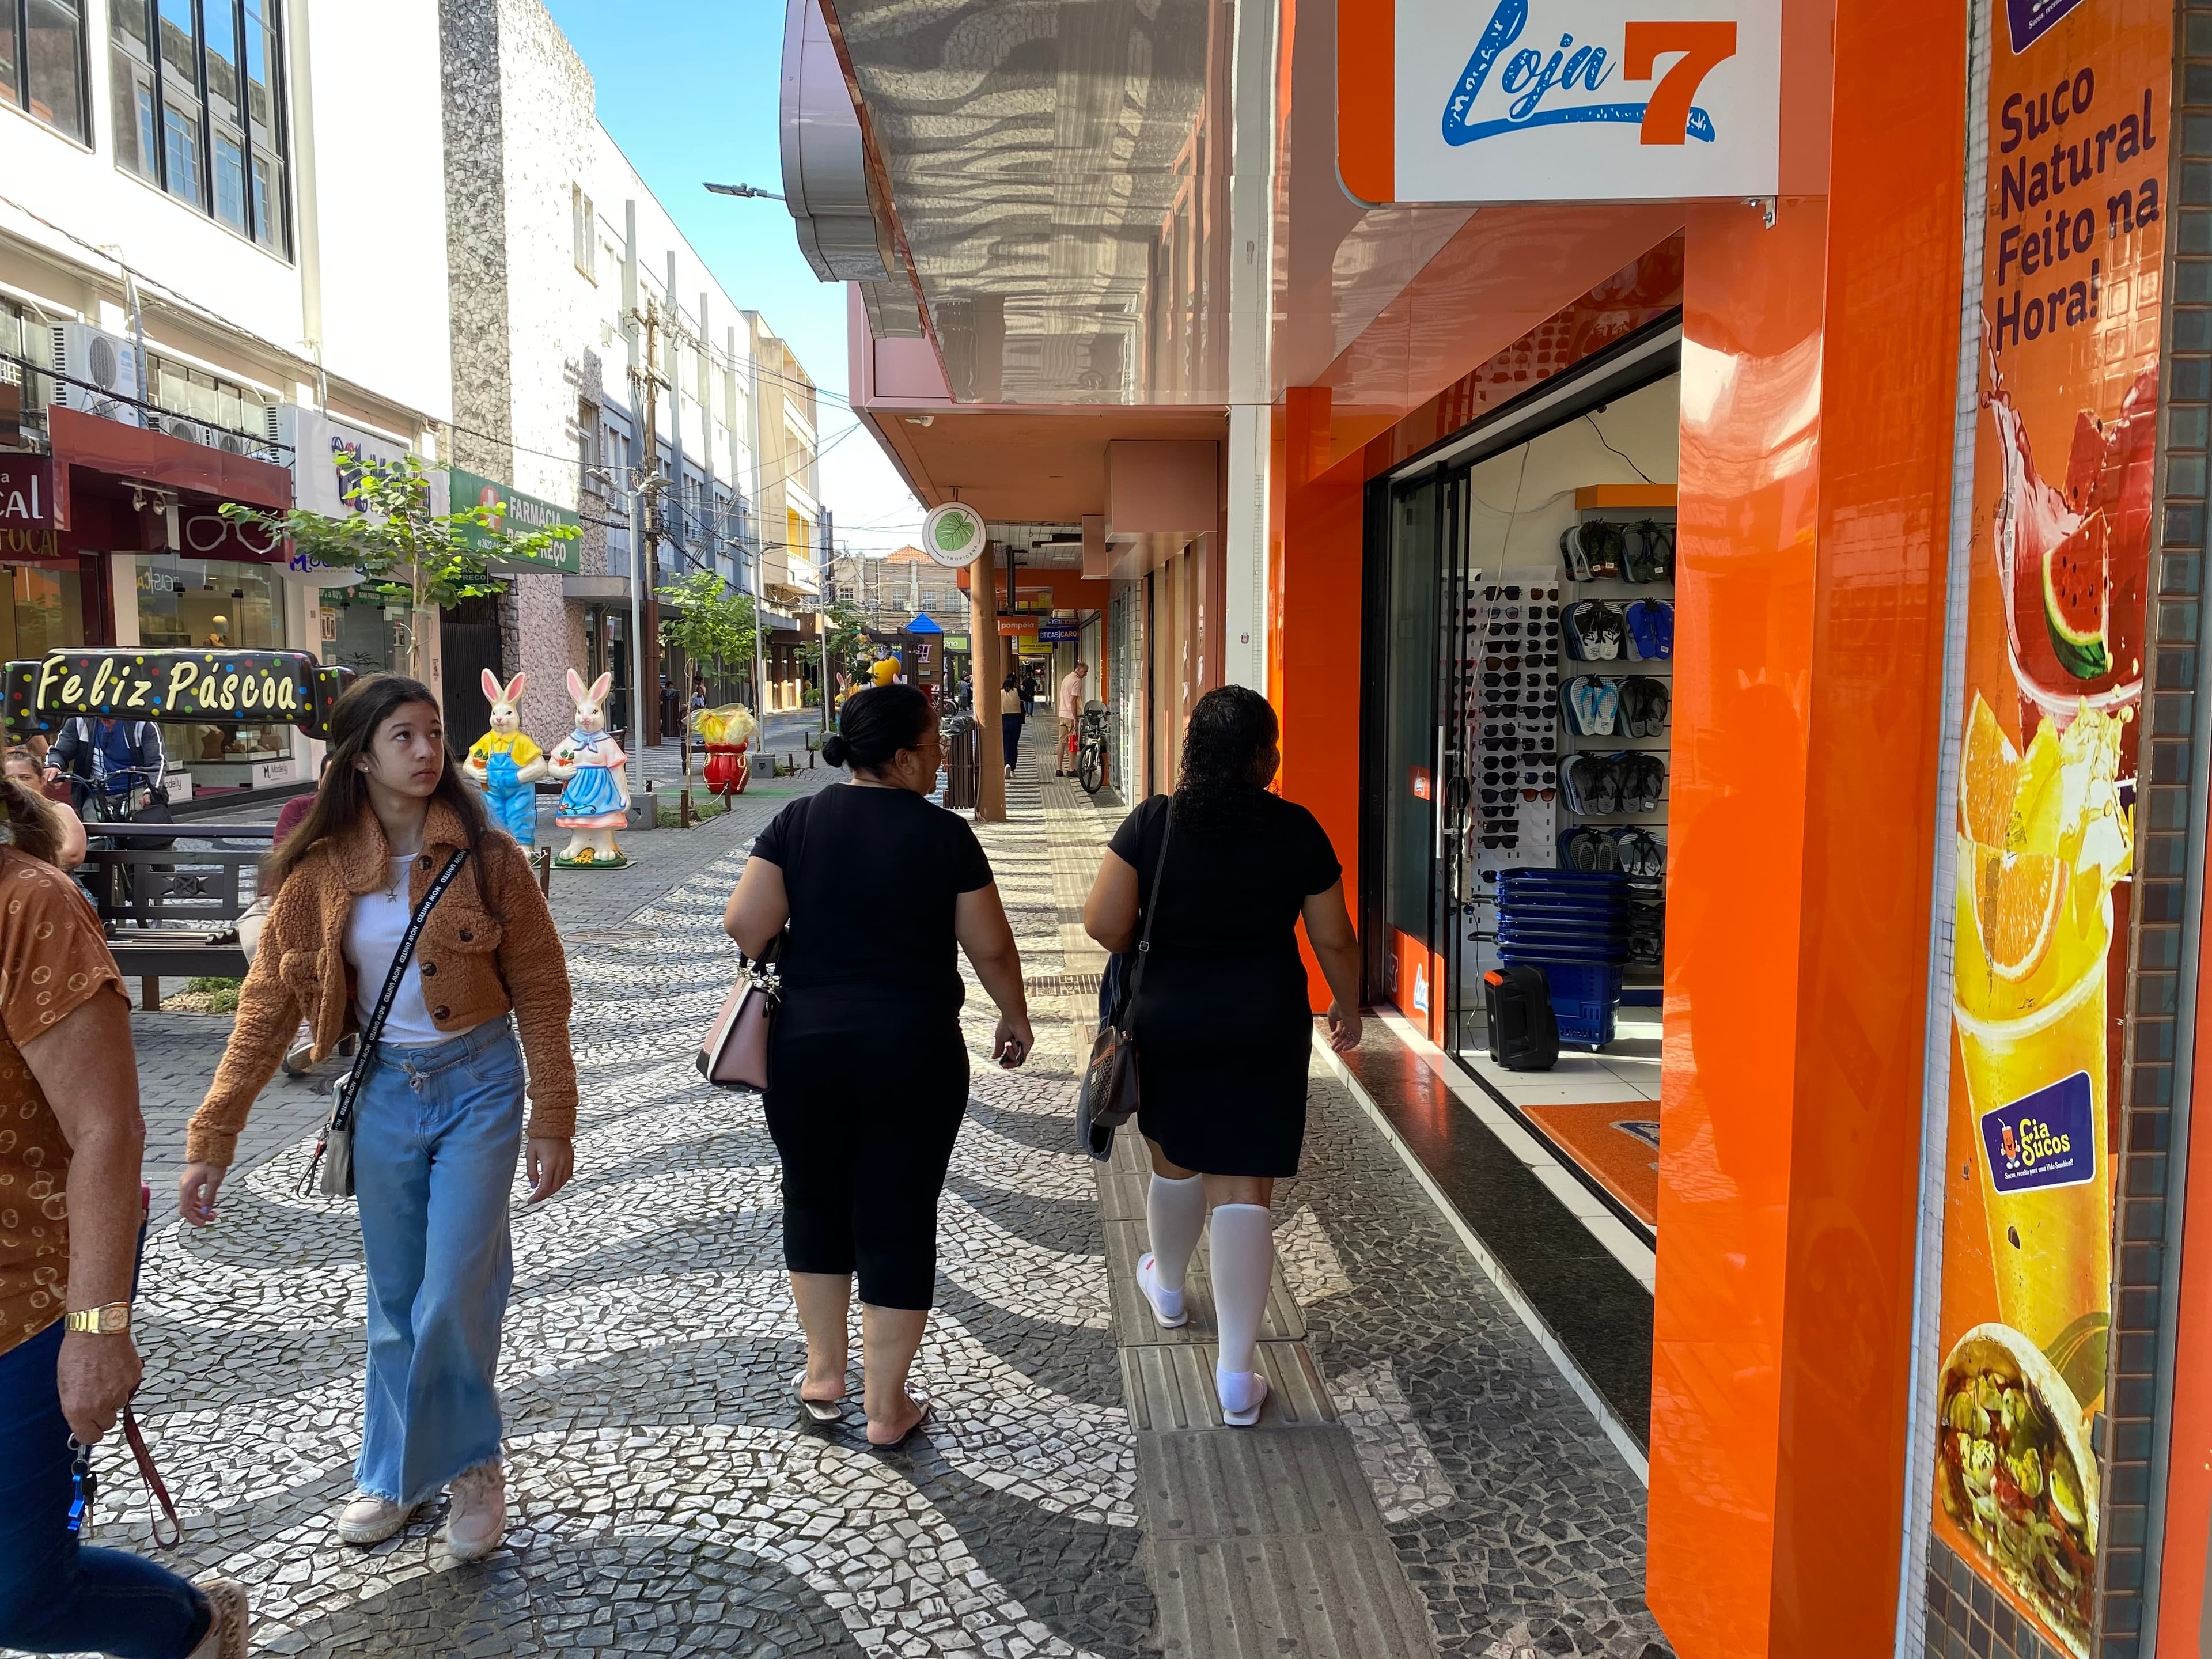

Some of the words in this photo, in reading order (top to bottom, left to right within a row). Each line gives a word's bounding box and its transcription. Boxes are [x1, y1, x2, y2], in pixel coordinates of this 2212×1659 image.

[1442, 0, 1616, 146] Loja
[1623, 21, 1737, 145] 7
[2001, 67, 2094, 154] Suco
[2001, 88, 2156, 220] Natural
[1998, 208, 2095, 286] Feito
[2107, 177, 2159, 239] na
[1996, 258, 2100, 351] Hora!
[509, 496, 562, 527] FARMÁCIA
[37, 655, 152, 710] Feliz
[166, 661, 297, 710] Páscoa
[165, 778, 181, 790] odelly
[440, 863, 457, 883] UNITED
[429, 885, 442, 902] NOW
[416, 901, 432, 923] UNITED
[407, 925, 419, 942] NOW
[399, 942, 412, 963] UNITED
[391, 965, 402, 982] NOW
[384, 982, 396, 1002] UNITED
[378, 1005, 386, 1021] NOW
[369, 1021, 380, 1041] UNITED
[362, 1043, 372, 1060] NOW
[354, 1059, 365, 1079] UNITED
[347, 1081, 357, 1097] NOW
[339, 1096, 350, 1116] UNITED
[2019, 1118, 2050, 1140] Cia
[2021, 1133, 2071, 1166] Sucos
